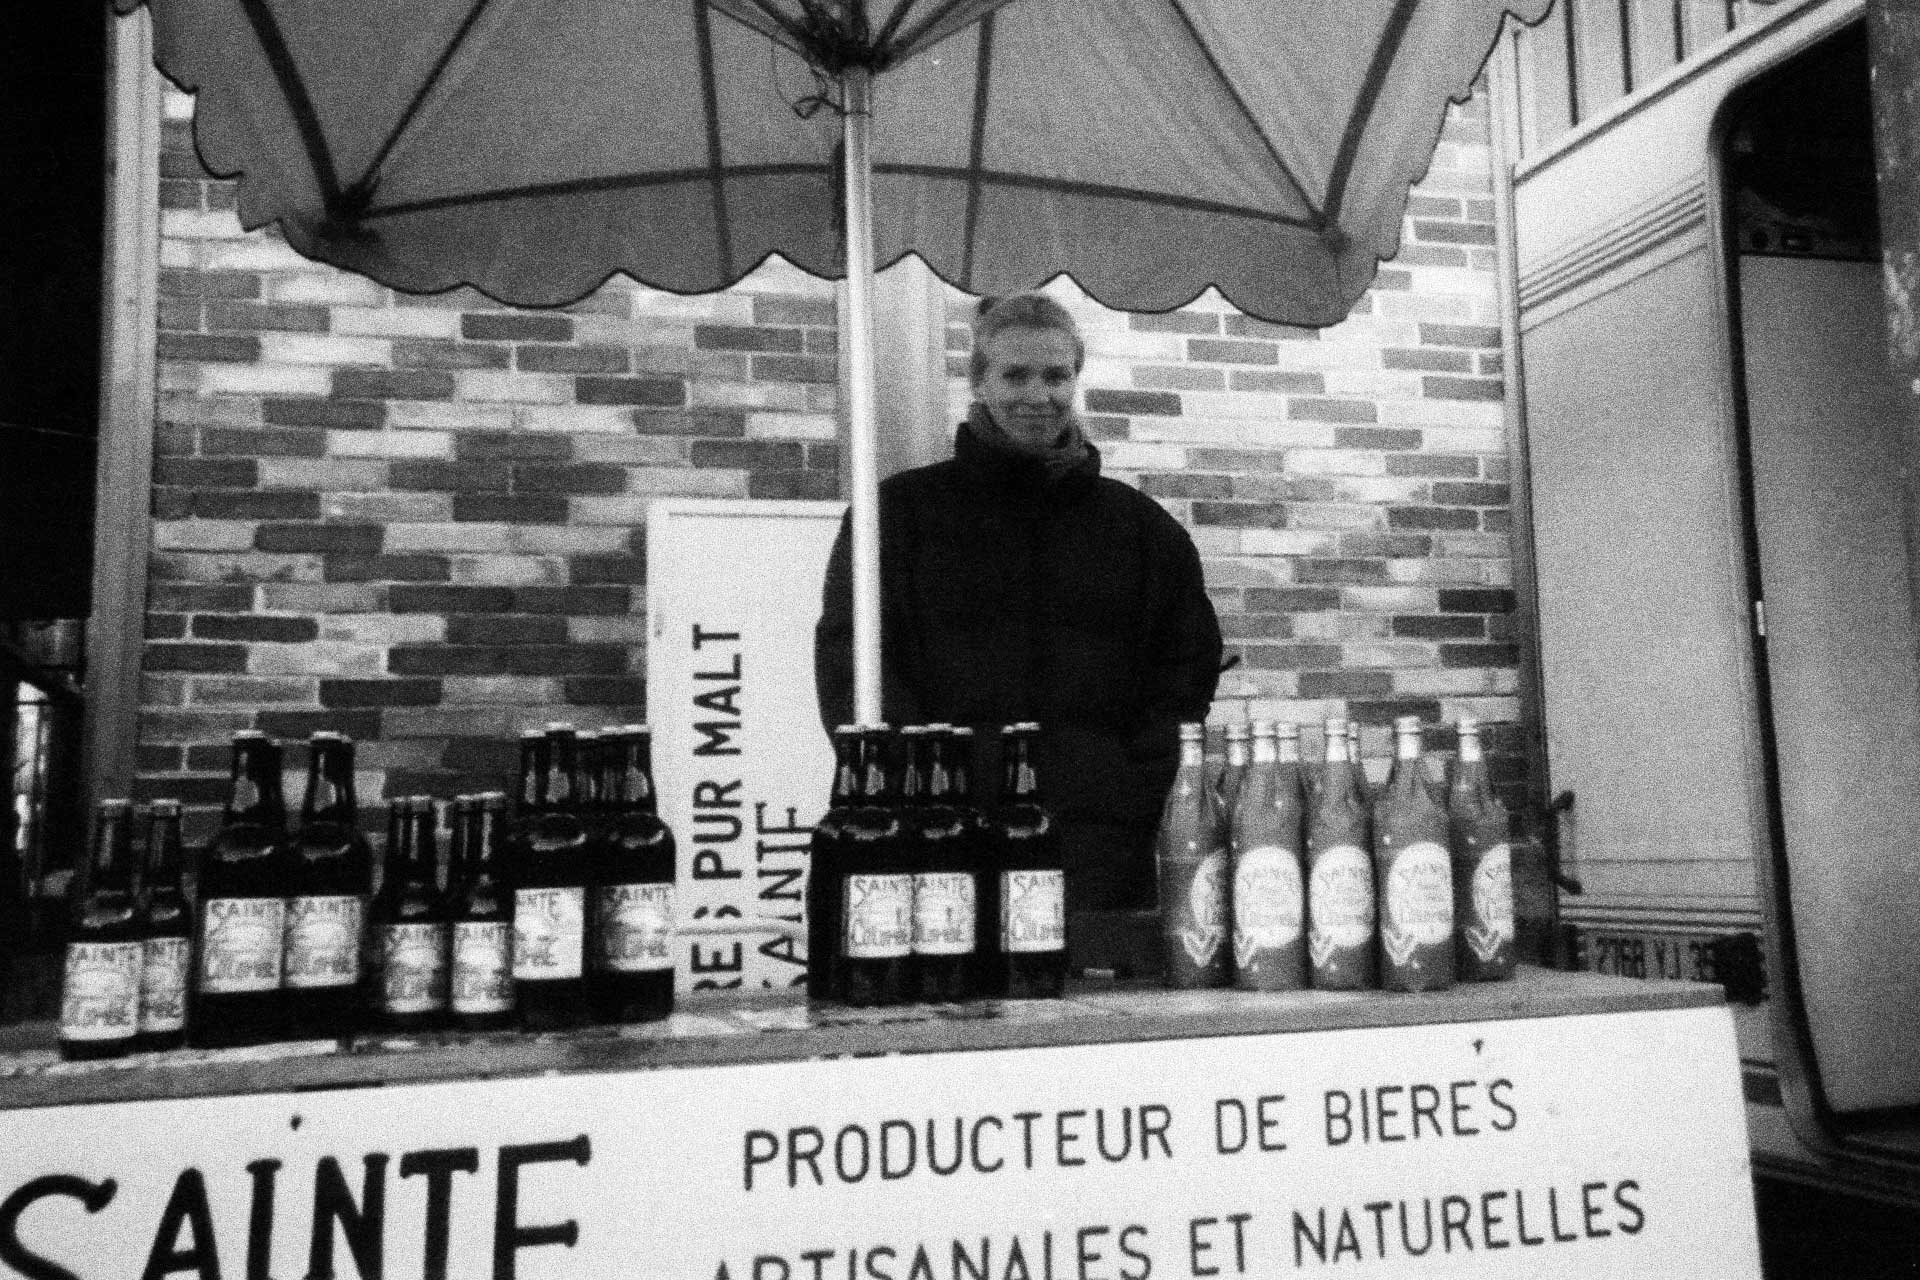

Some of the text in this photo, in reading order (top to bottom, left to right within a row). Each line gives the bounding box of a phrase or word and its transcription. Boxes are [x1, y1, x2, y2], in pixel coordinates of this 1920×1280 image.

[692, 623, 743, 757] MALT
[692, 779, 743, 881] PUR
[743, 1077, 1518, 1192] PRODUCTEUR DE BIERES
[1189, 1212, 1254, 1277] ET
[1293, 1179, 1646, 1266] NATURELLES
